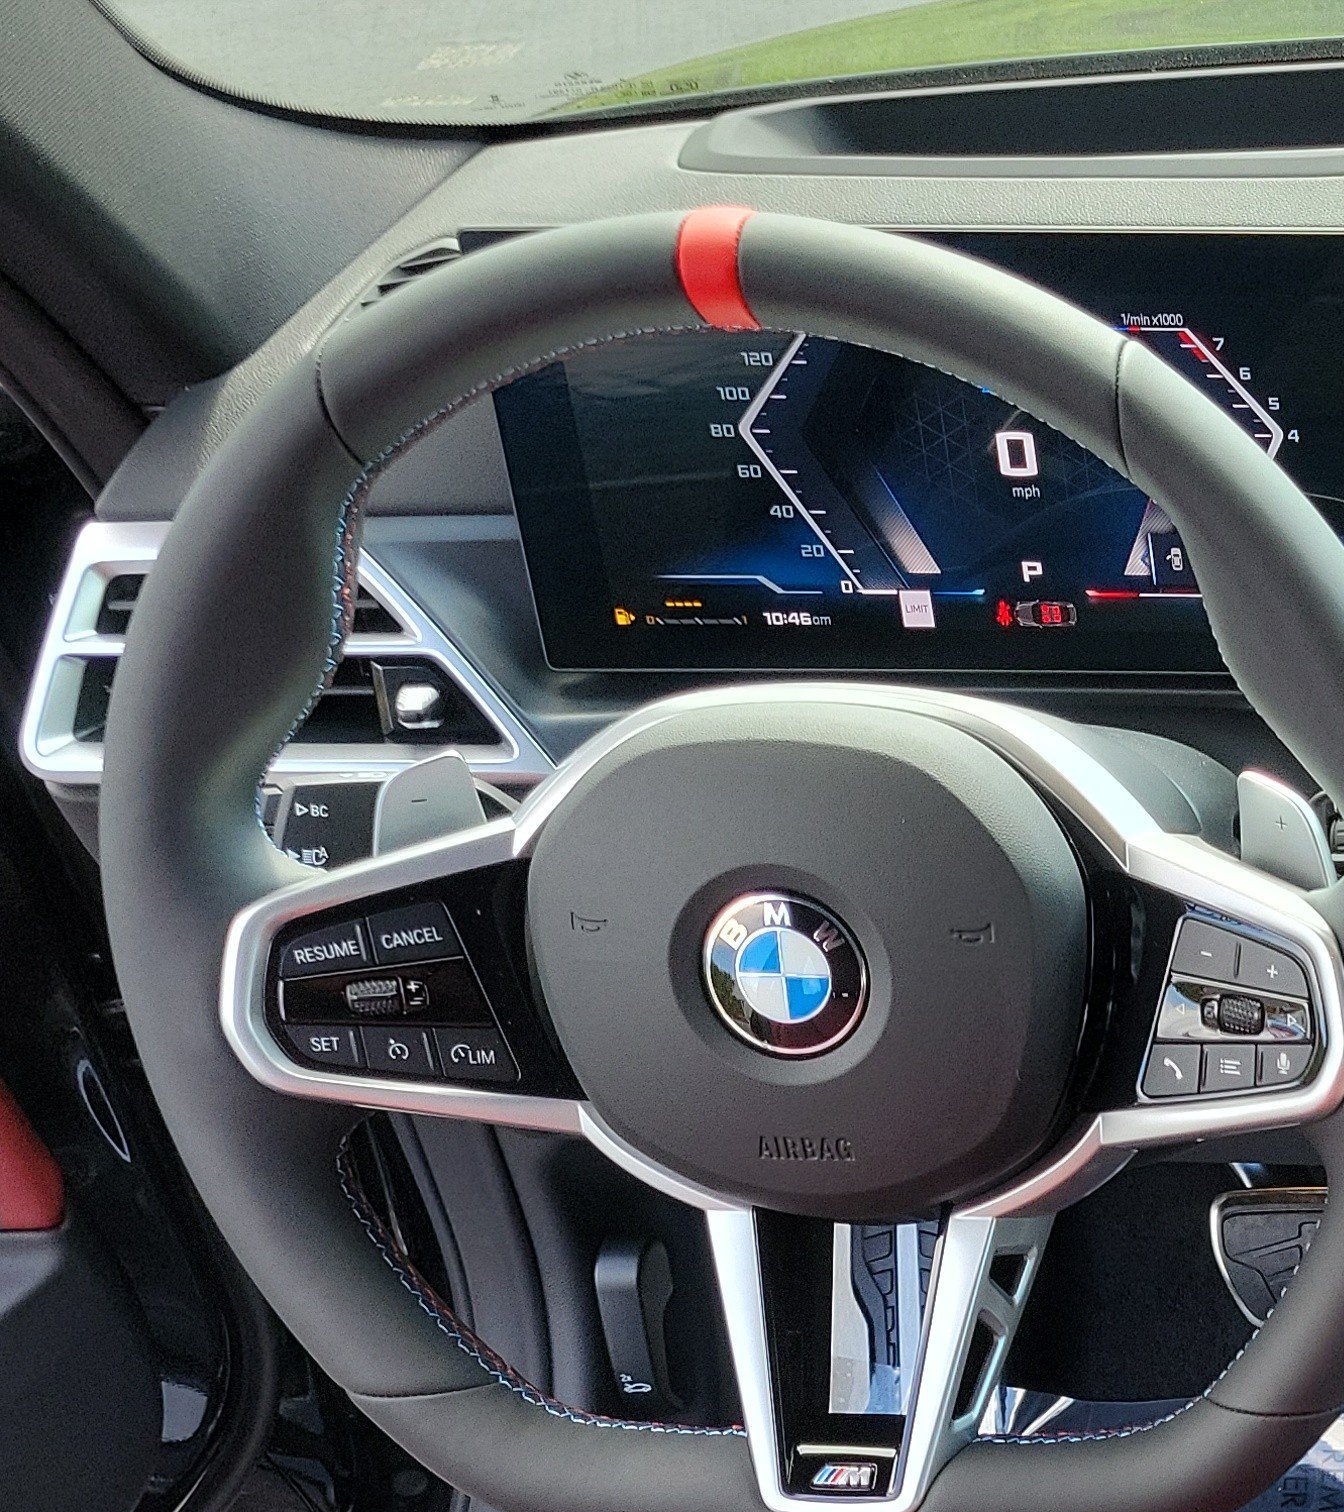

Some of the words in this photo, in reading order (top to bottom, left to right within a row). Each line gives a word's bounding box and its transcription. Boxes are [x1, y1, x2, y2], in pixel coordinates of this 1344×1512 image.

[1152, 314, 1184, 326] x1000
[1212, 337, 1225, 350] 7
[740, 351, 774, 366] 120
[1239, 367, 1252, 380] 6
[716, 386, 750, 401] 100
[1268, 397, 1280, 410] 5
[710, 423, 735, 438] 80
[1287, 429, 1300, 443] 4
[995, 431, 1038, 477] 0
[737, 464, 762, 479] 60
[1012, 485, 1041, 501] mph
[769, 505, 794, 519] 40
[800, 544, 825, 558] 20
[1022, 561, 1043, 582] P
[841, 579, 853, 593] 0
[904, 604, 929, 614] LIMIT
[763, 612, 831, 626] 10:46am
[309, 802, 329, 818] BC
[718, 901, 846, 953] BMW
[294, 940, 360, 965] RESUME
[381, 926, 444, 950] CANCEL
[310, 1037, 340, 1052] SET
[469, 1050, 495, 1065] LIM
[758, 1135, 855, 1162] AIRBAG
